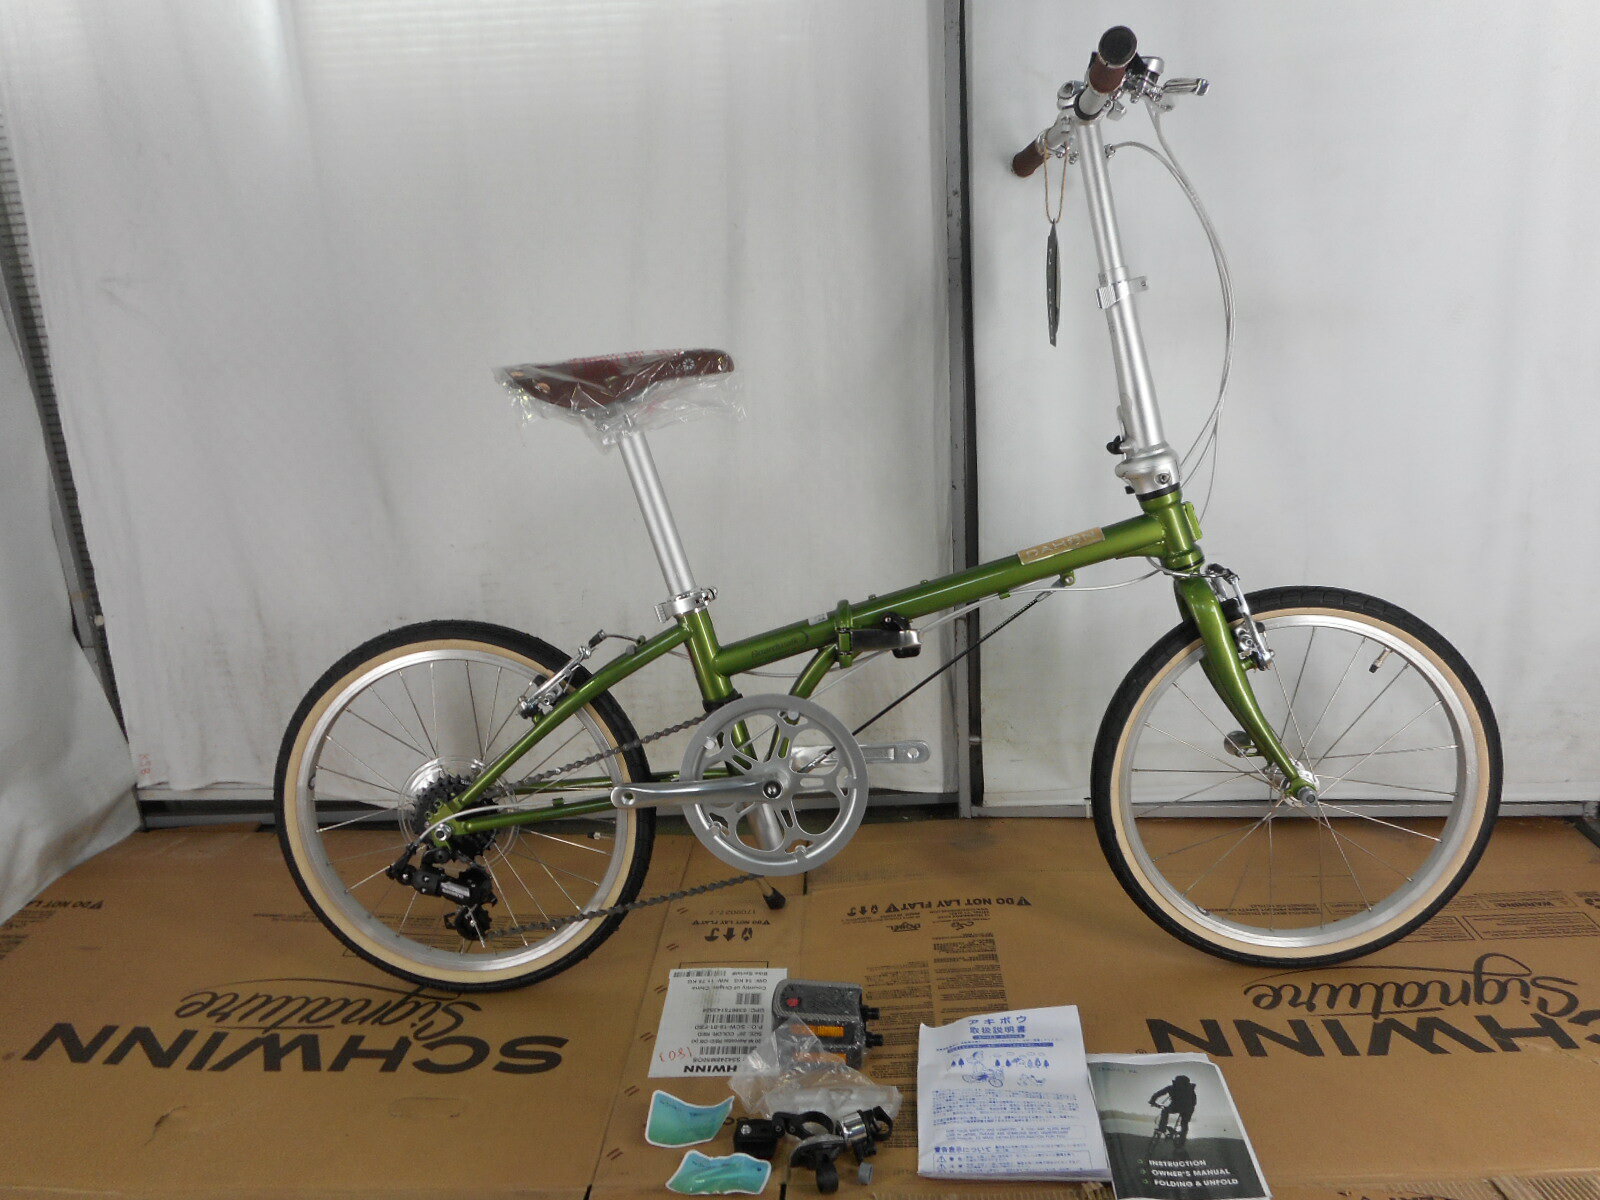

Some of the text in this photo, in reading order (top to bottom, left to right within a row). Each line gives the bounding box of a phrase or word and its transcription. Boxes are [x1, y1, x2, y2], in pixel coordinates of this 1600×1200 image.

[900, 897, 1014, 911] DO NOT LAY FLAT
[1243, 954, 1580, 1022] Signature
[174, 977, 482, 1041] Signature
[968, 1015, 1027, 1025] アキボウ
[969, 1025, 1026, 1034] 取扱説明書
[23, 1022, 571, 1075] SCHWINN
[683, 1065, 738, 1073] HWINN
[1148, 1159, 1207, 1167] INSTRUCTION
[1151, 1168, 1231, 1178] OWNER'S MANUAL
[1154, 1178, 1239, 1188] FOLDING & UNFOLD
